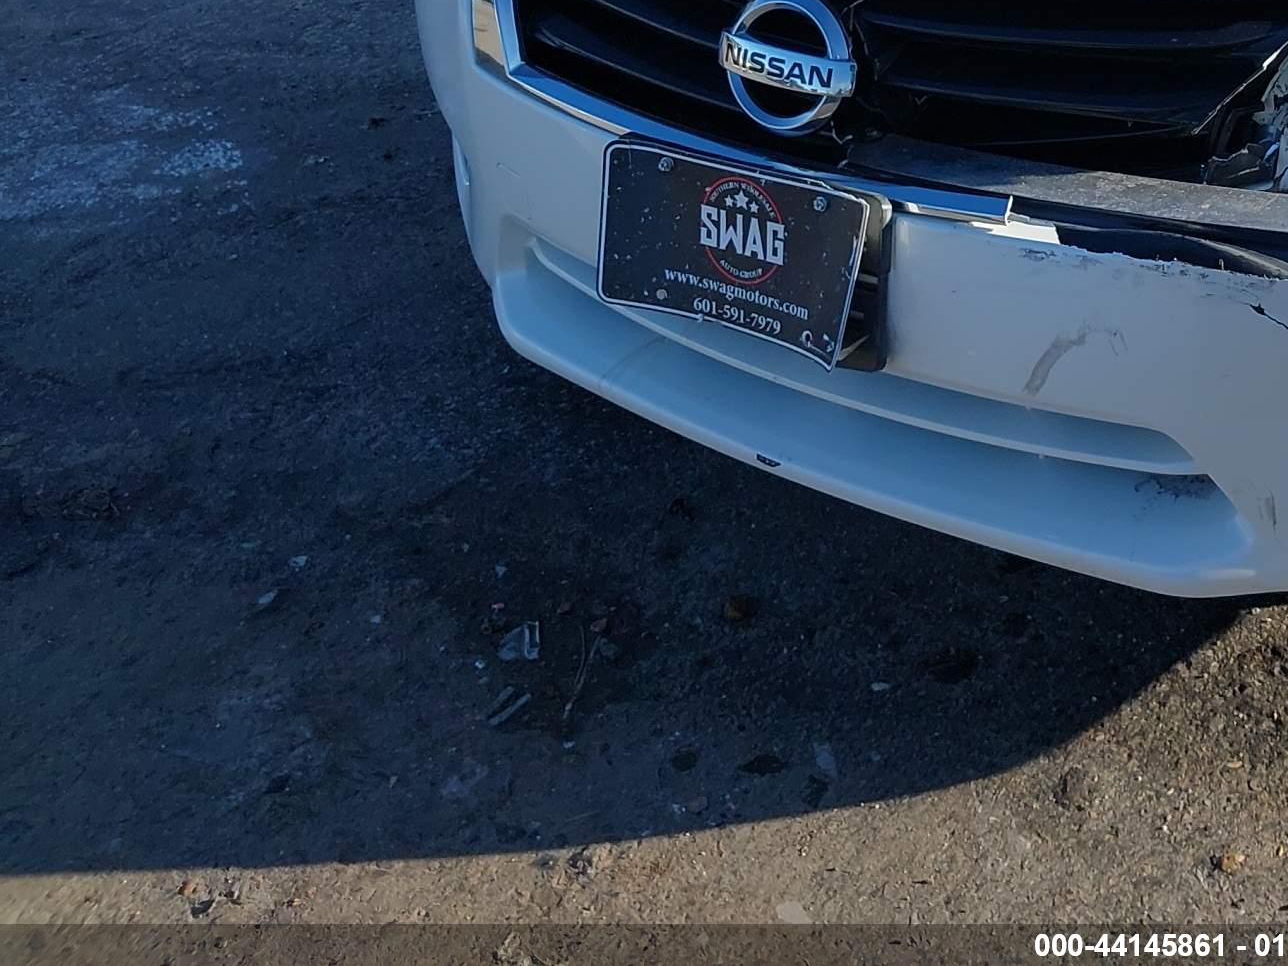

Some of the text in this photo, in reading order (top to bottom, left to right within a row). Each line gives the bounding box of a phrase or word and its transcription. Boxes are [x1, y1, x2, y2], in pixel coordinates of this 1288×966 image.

[725, 42, 833, 89] NISSAN
[700, 204, 785, 265] SWAG
[719, 259, 739, 276] AUTO
[664, 268, 809, 320] www.swagmotors.com
[693, 297, 781, 335] 601-591-7979
